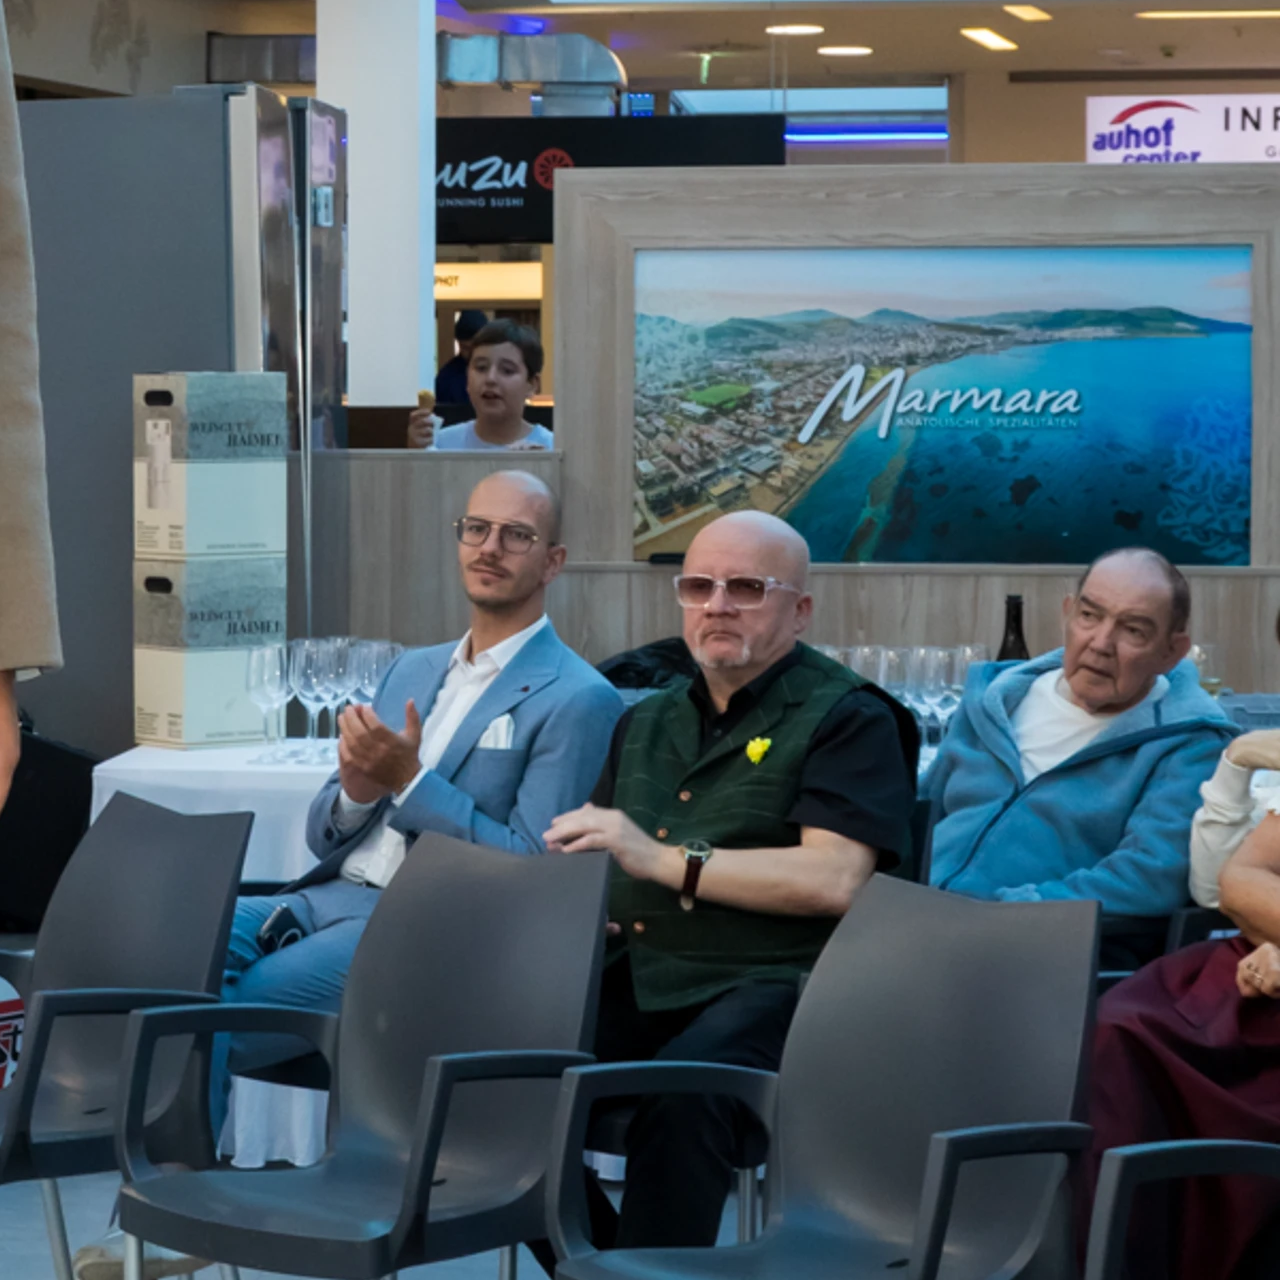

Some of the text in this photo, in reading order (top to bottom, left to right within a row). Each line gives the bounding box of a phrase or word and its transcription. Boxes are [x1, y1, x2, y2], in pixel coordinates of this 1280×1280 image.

[1092, 117, 1175, 152] auhof
[490, 197, 524, 208] SUSHI
[797, 363, 1083, 444] Marmara
